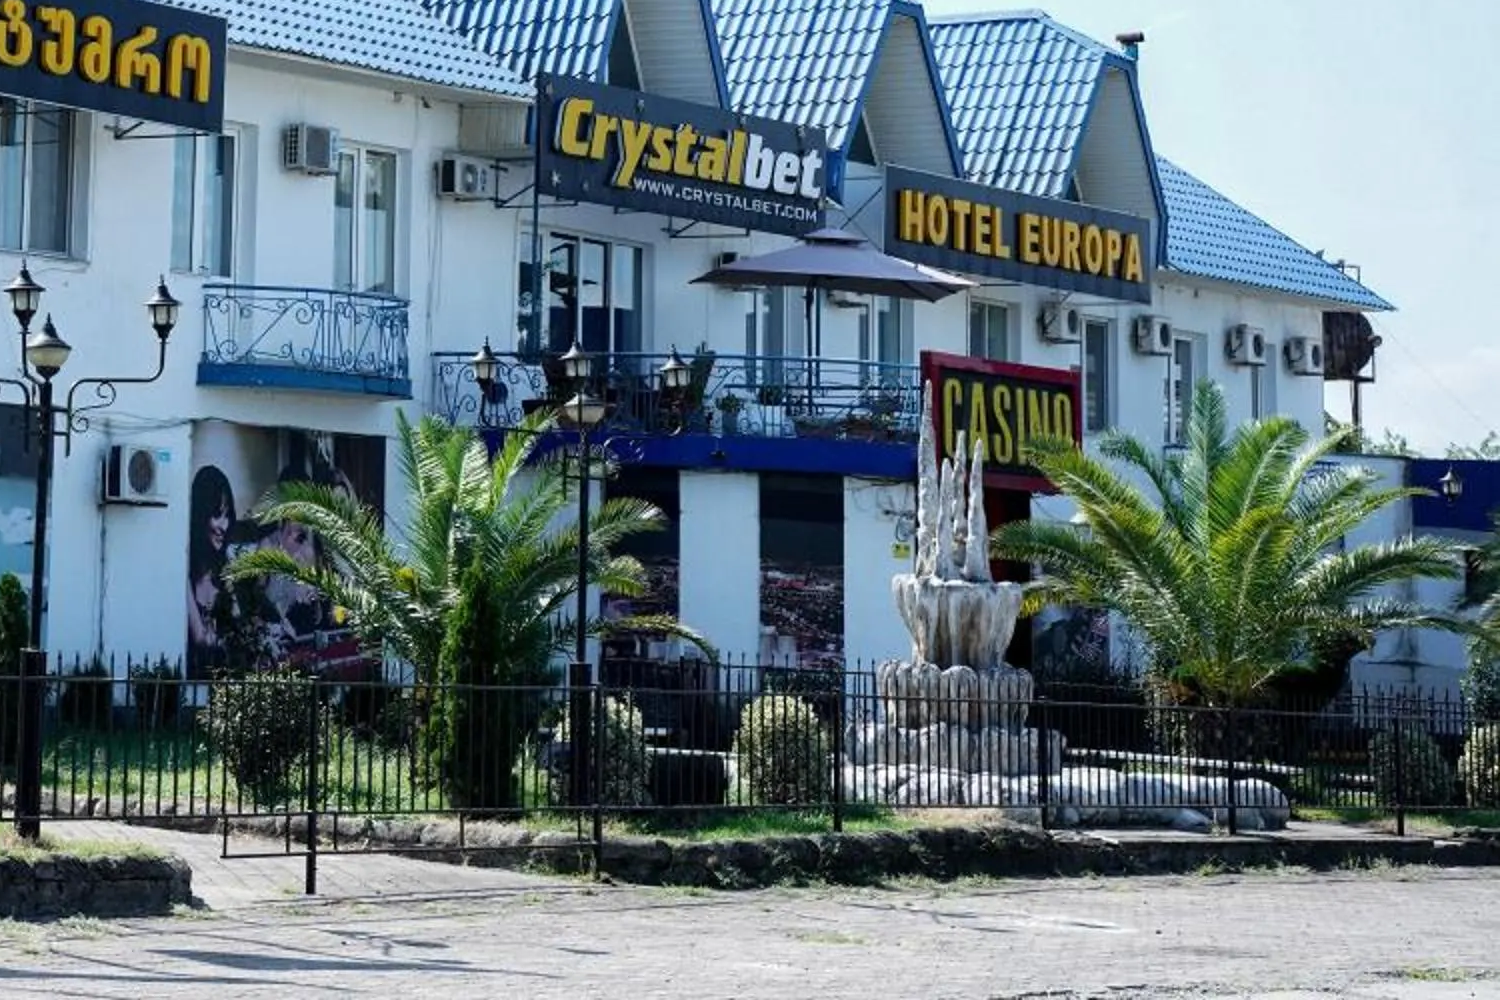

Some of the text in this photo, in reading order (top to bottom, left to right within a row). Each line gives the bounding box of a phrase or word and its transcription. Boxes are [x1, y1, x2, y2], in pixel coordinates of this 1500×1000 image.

[555, 96, 823, 199] Crystalbet
[633, 177, 818, 223] WWW.CRYSTALBET.COM
[899, 189, 1144, 283] HOTEL EUROPA
[943, 377, 1074, 467] CASINO
